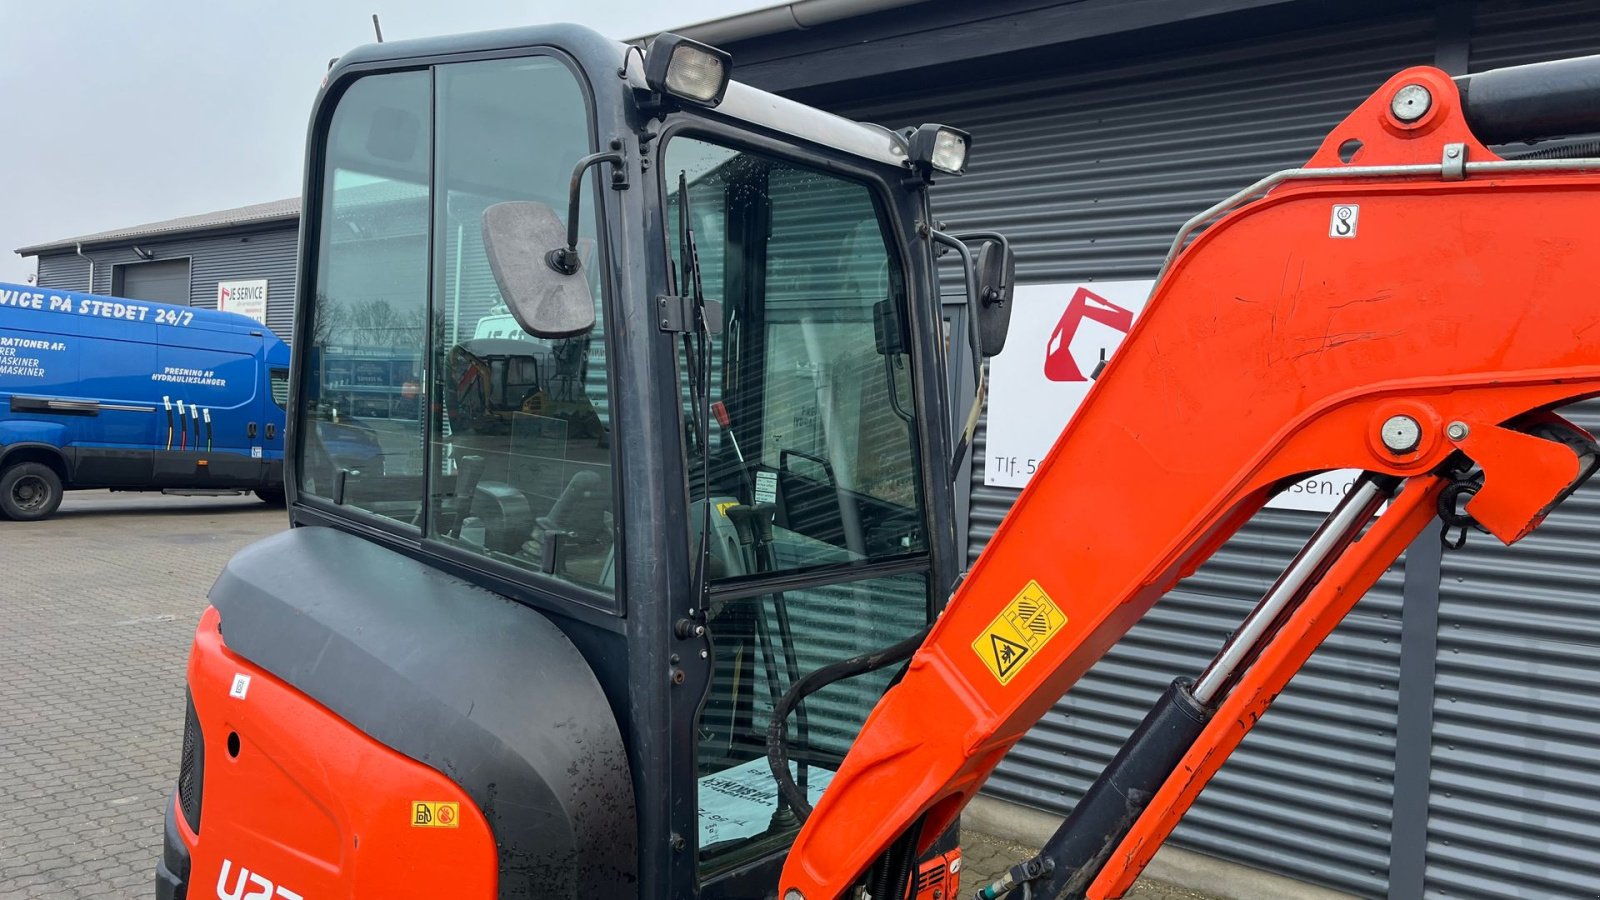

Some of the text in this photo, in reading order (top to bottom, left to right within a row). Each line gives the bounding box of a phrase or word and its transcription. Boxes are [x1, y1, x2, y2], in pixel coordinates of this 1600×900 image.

[237, 286, 263, 300] SERVICE
[50, 295, 71, 312] PÅ
[79, 300, 149, 321] STEDET
[154, 309, 194, 326] 24/7
[0, 337, 49, 350] RATIONER
[164, 367, 203, 377] PRESNING
[151, 373, 226, 387] HYDRAULIKSLANGER
[995, 456, 1021, 478] Tlf.
[1286, 478, 1358, 497] sen.d
